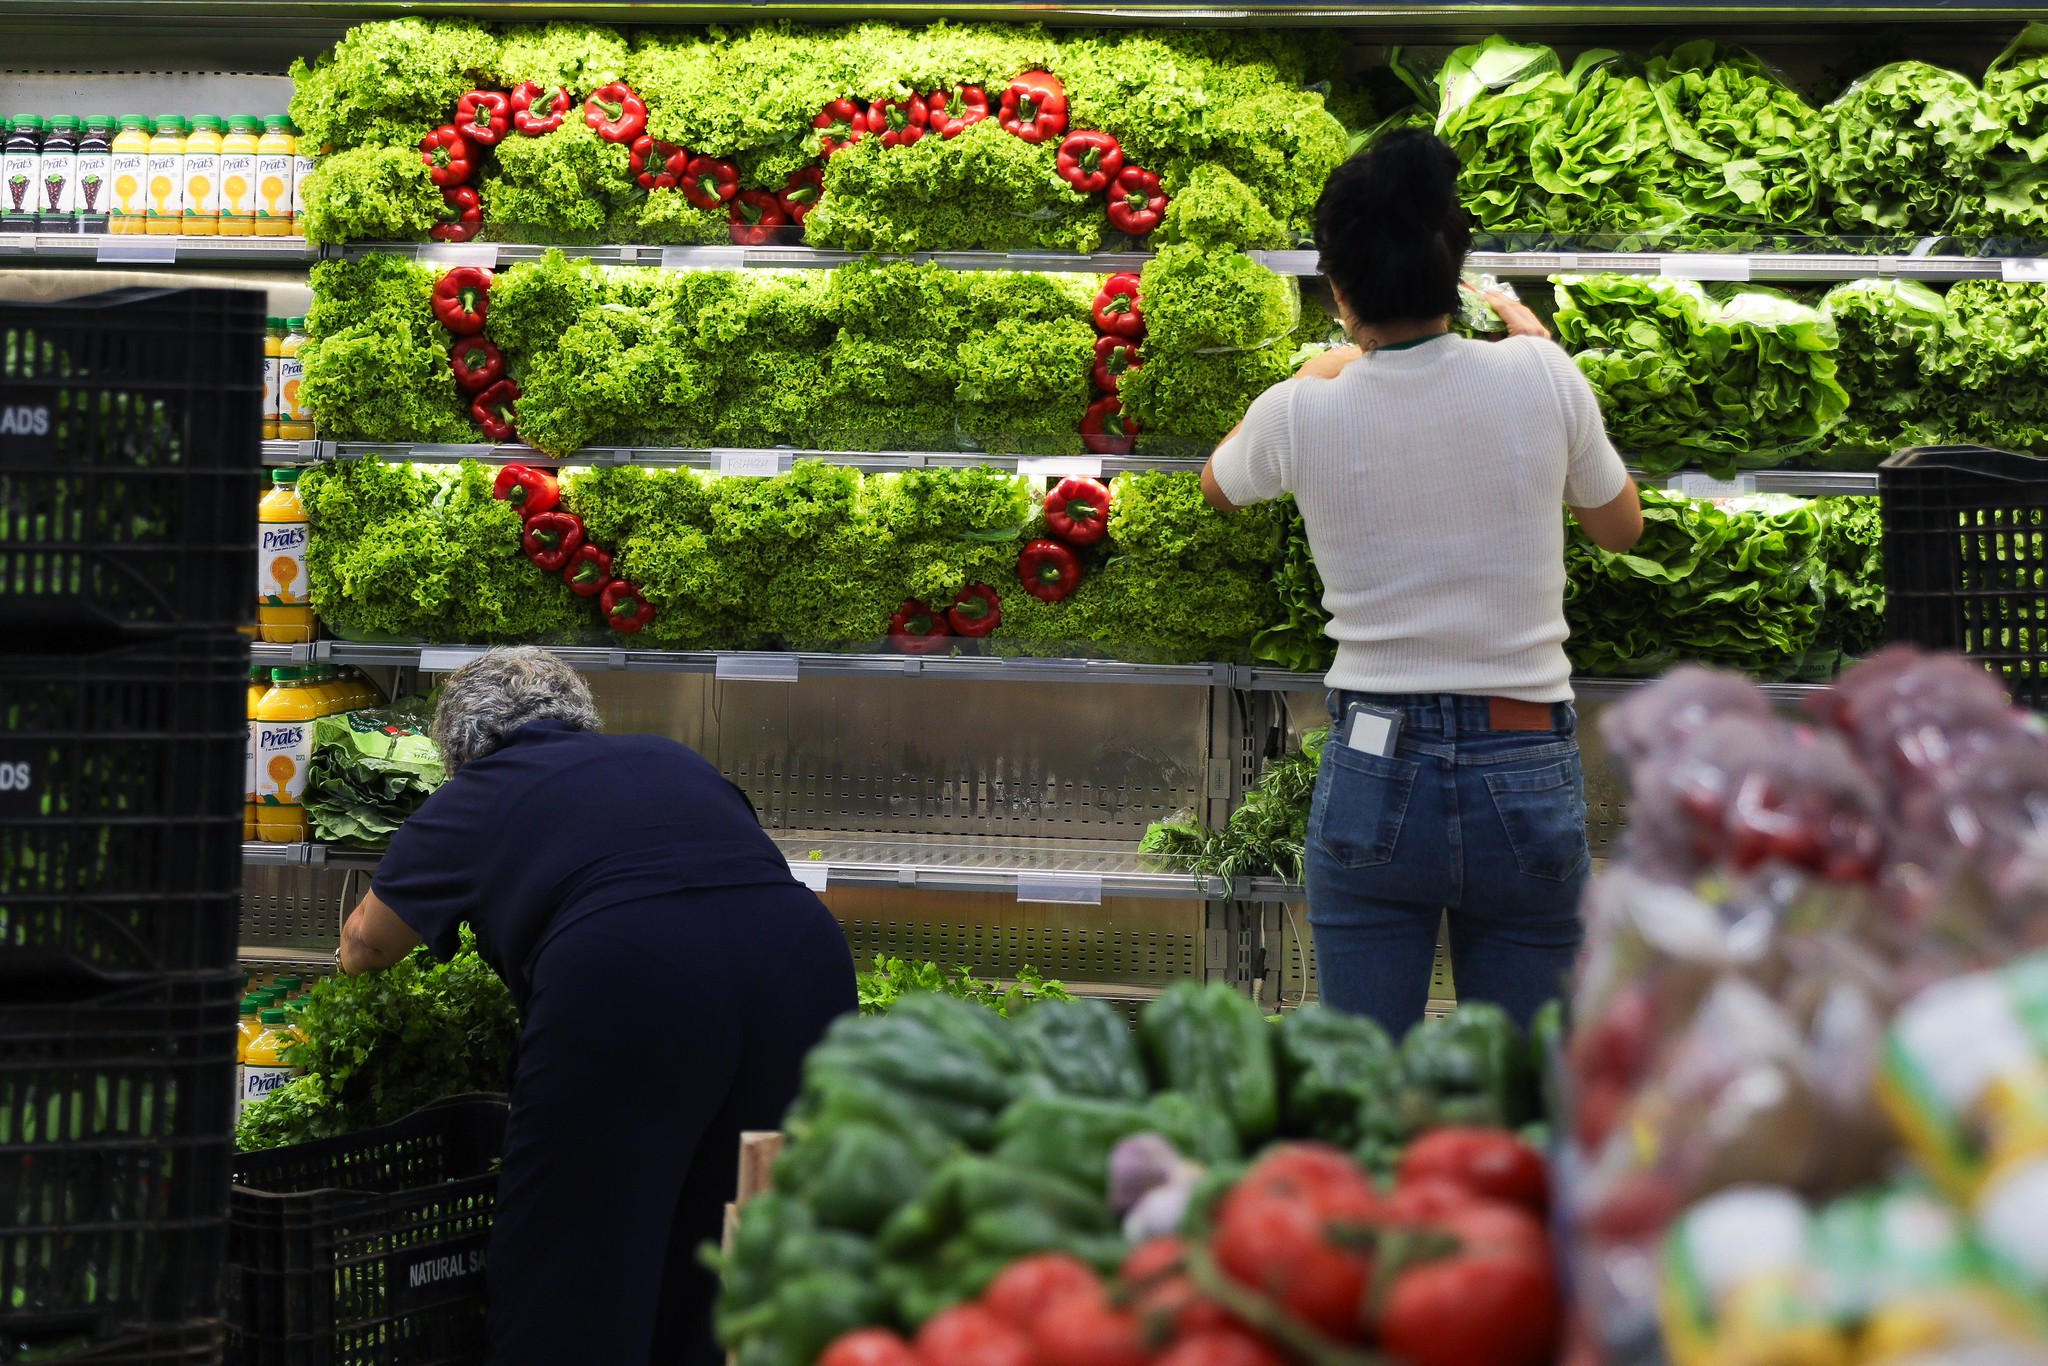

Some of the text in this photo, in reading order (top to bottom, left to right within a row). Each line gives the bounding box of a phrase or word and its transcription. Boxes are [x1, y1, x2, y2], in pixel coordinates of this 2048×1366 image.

[0, 405, 49, 436] ADS
[409, 1248, 487, 1288] NATURAL SA
